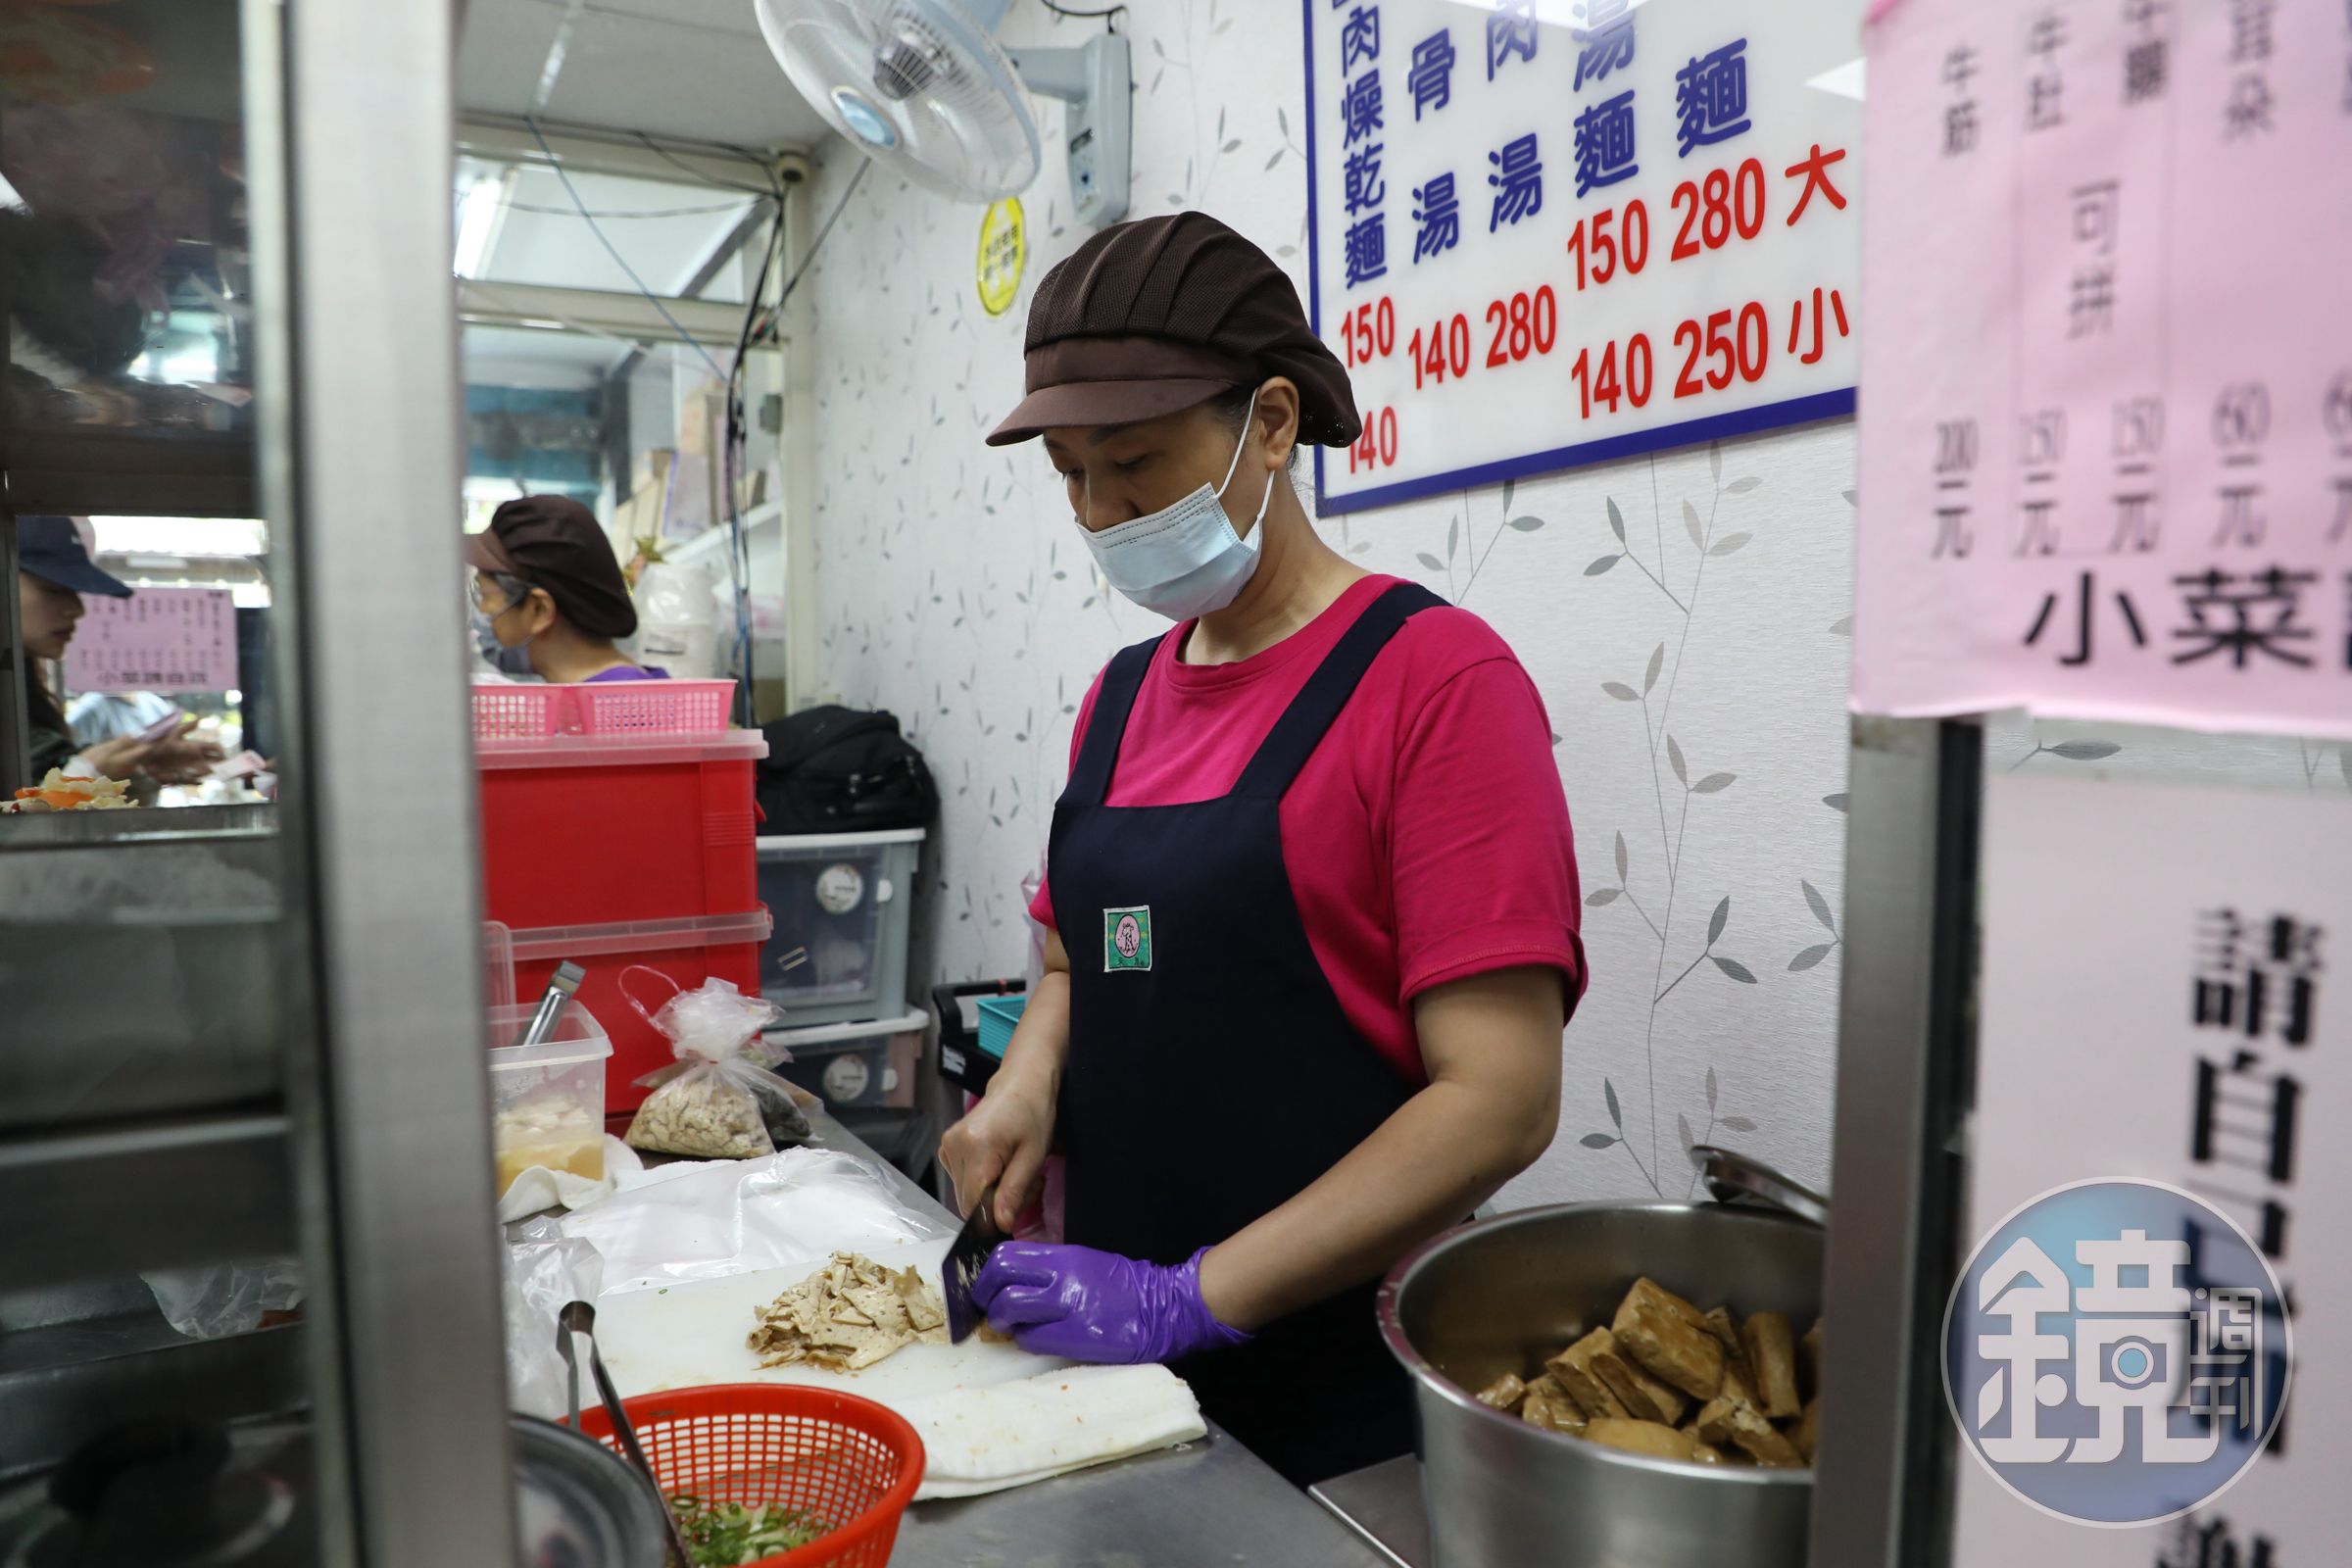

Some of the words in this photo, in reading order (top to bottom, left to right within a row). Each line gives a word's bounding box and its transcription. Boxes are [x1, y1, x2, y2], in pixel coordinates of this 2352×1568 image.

[1675, 38, 1752, 158] 麵
[1334, 0, 1387, 289] 肉燥乾麵
[1785, 143, 1847, 226] 大
[1567, 198, 1648, 291] 150
[1670, 158, 1765, 262] 280
[1341, 296, 1395, 369] 150
[1407, 313, 1470, 391] 140
[1485, 284, 1556, 368] 280
[1673, 301, 1768, 399] 250
[1788, 287, 1850, 365] 小
[1570, 332, 1652, 420] 140
[2023, 567, 2352, 670] 小菜
